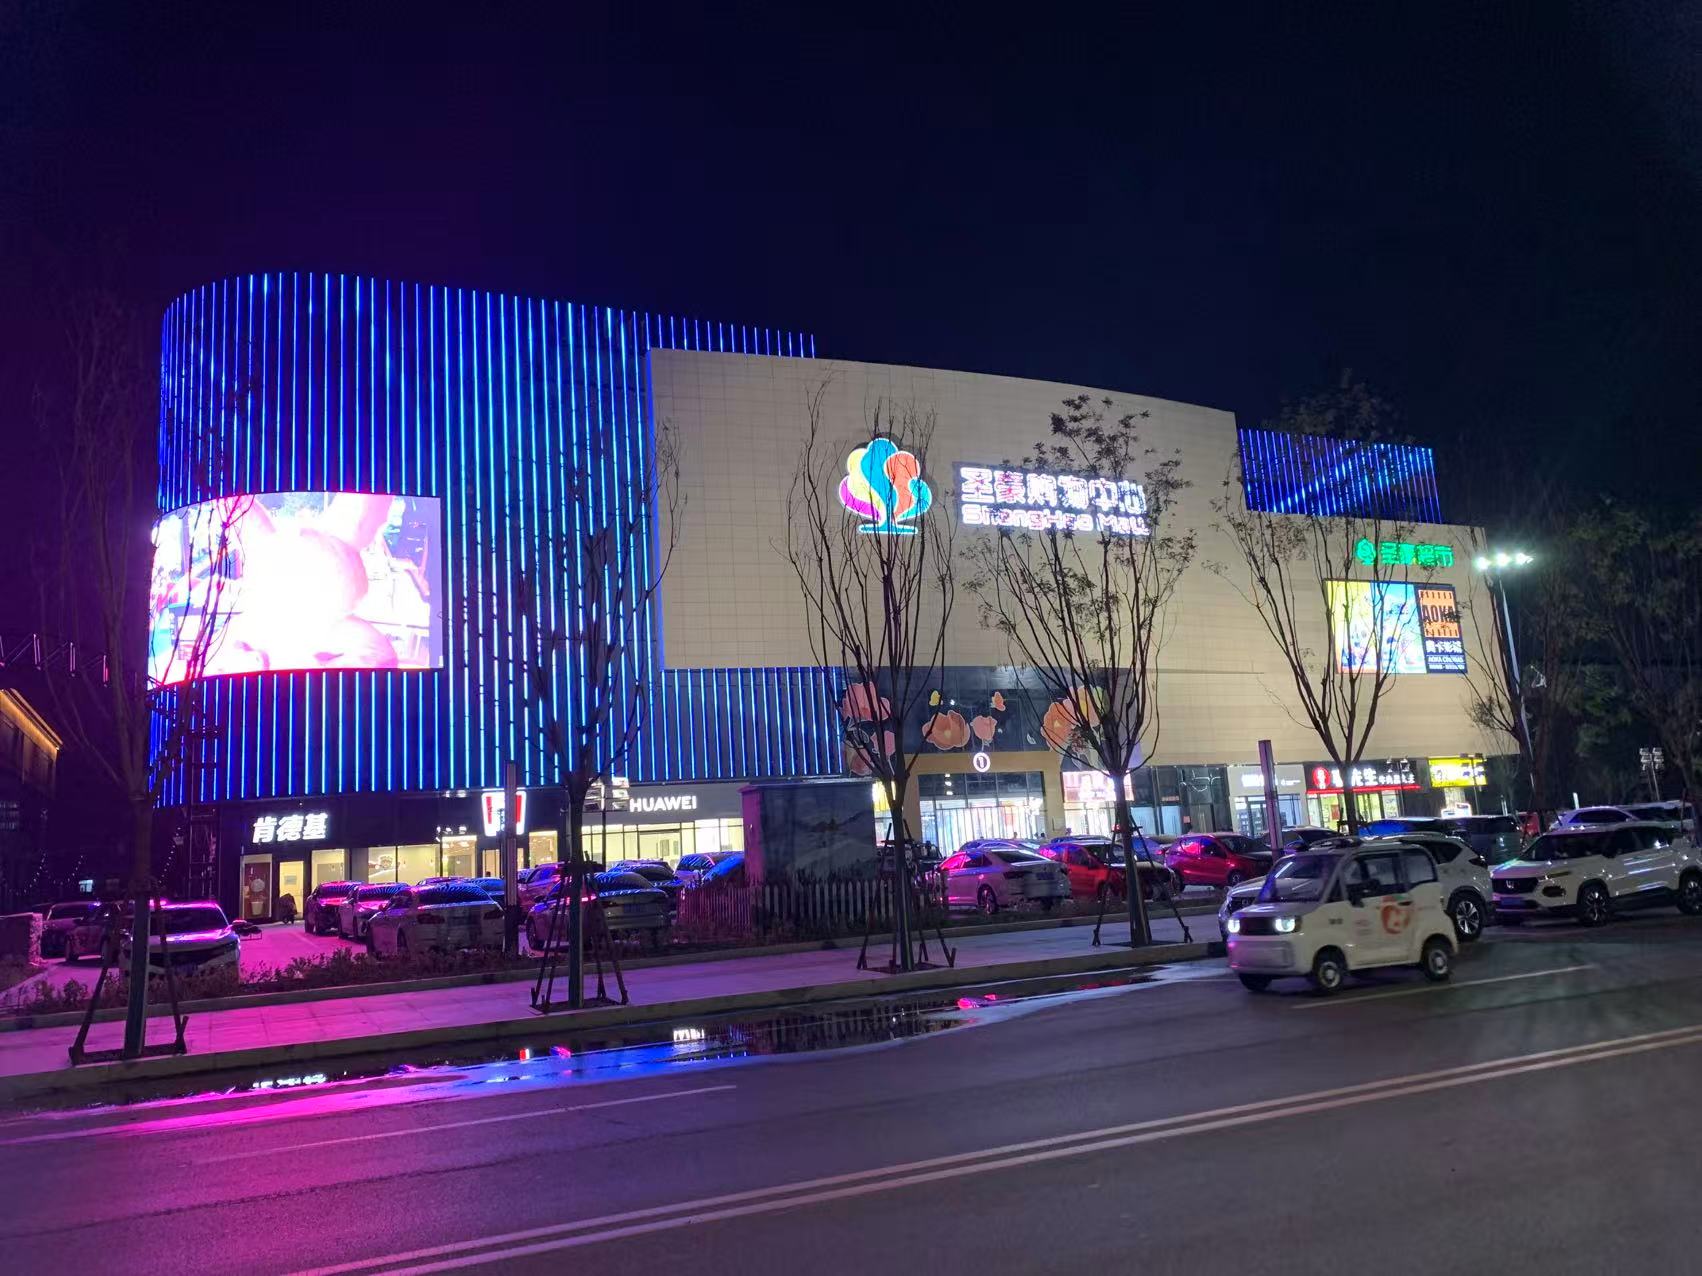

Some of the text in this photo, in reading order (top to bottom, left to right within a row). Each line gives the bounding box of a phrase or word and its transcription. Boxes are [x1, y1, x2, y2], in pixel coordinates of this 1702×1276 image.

[629, 795, 698, 813] HUAWEI
[252, 812, 329, 843] 肯德基
